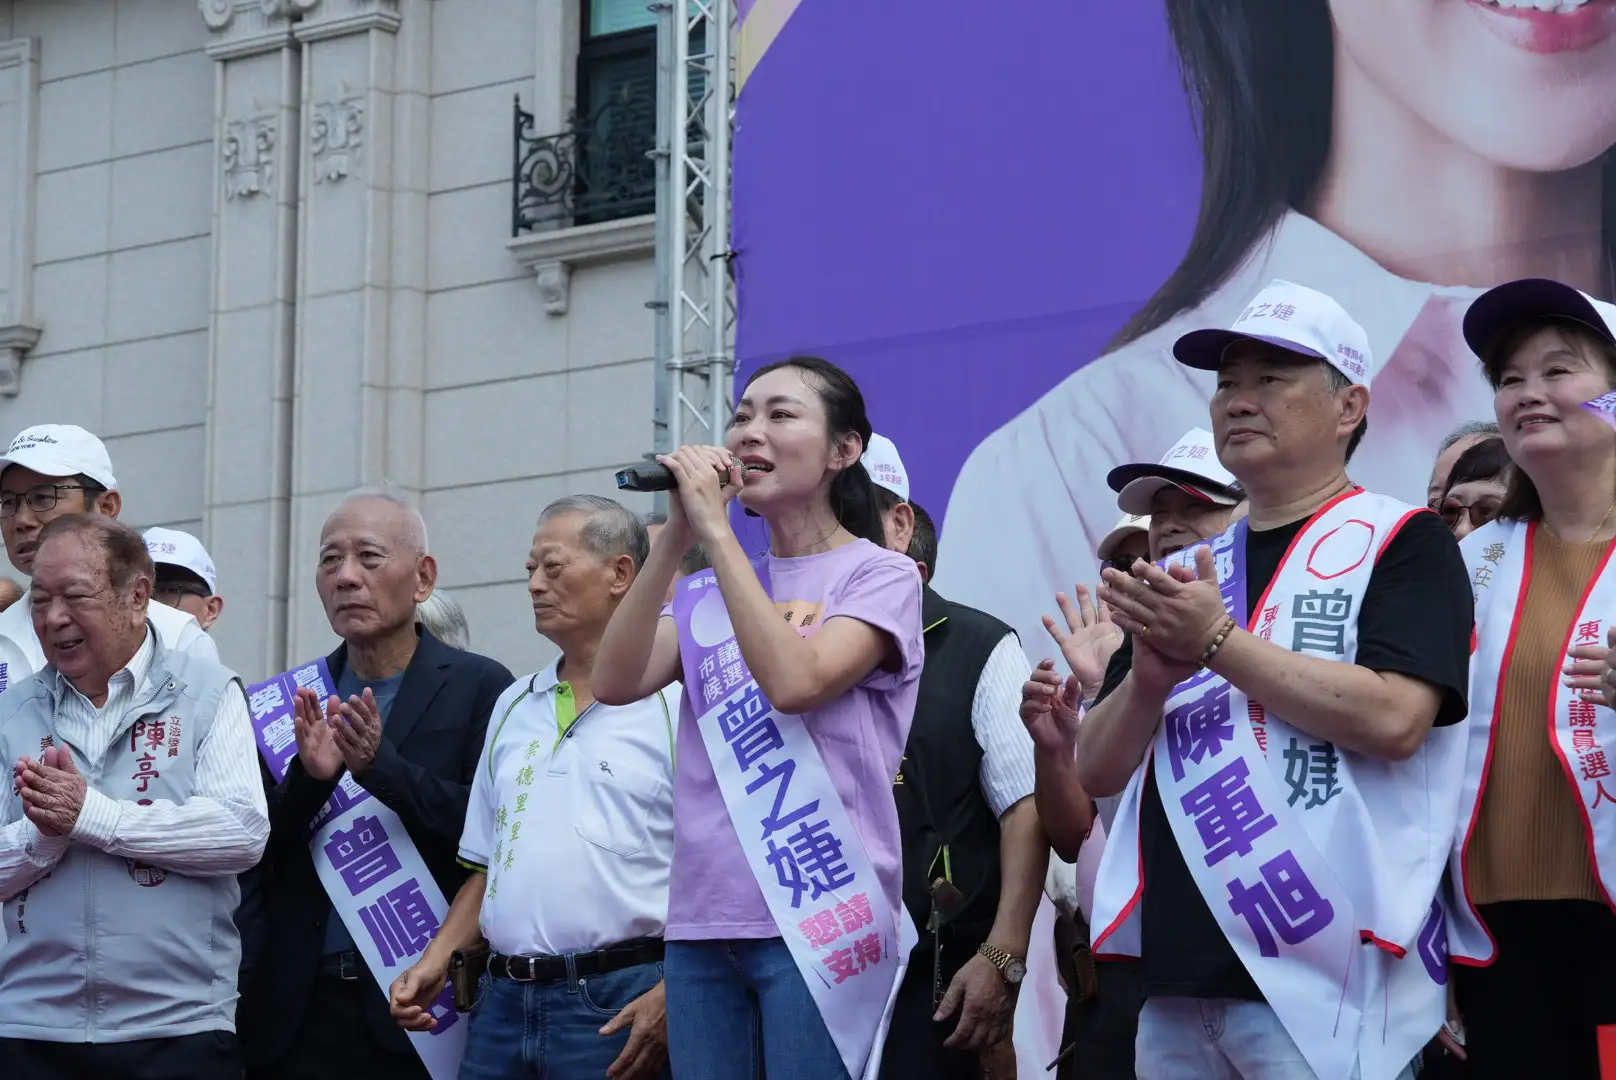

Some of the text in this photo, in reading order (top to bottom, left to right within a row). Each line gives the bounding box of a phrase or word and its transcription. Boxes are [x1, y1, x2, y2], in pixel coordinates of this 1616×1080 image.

[702, 661, 752, 705] 候選
[1283, 587, 1353, 811] 曾婕
[131, 719, 166, 805] 陳亭
[717, 684, 856, 909] 曾之婕
[1165, 683, 1335, 958] 陳軍旭
[323, 815, 461, 1036] 曾順
[797, 891, 875, 950] 懇請
[821, 932, 883, 985] 支持
